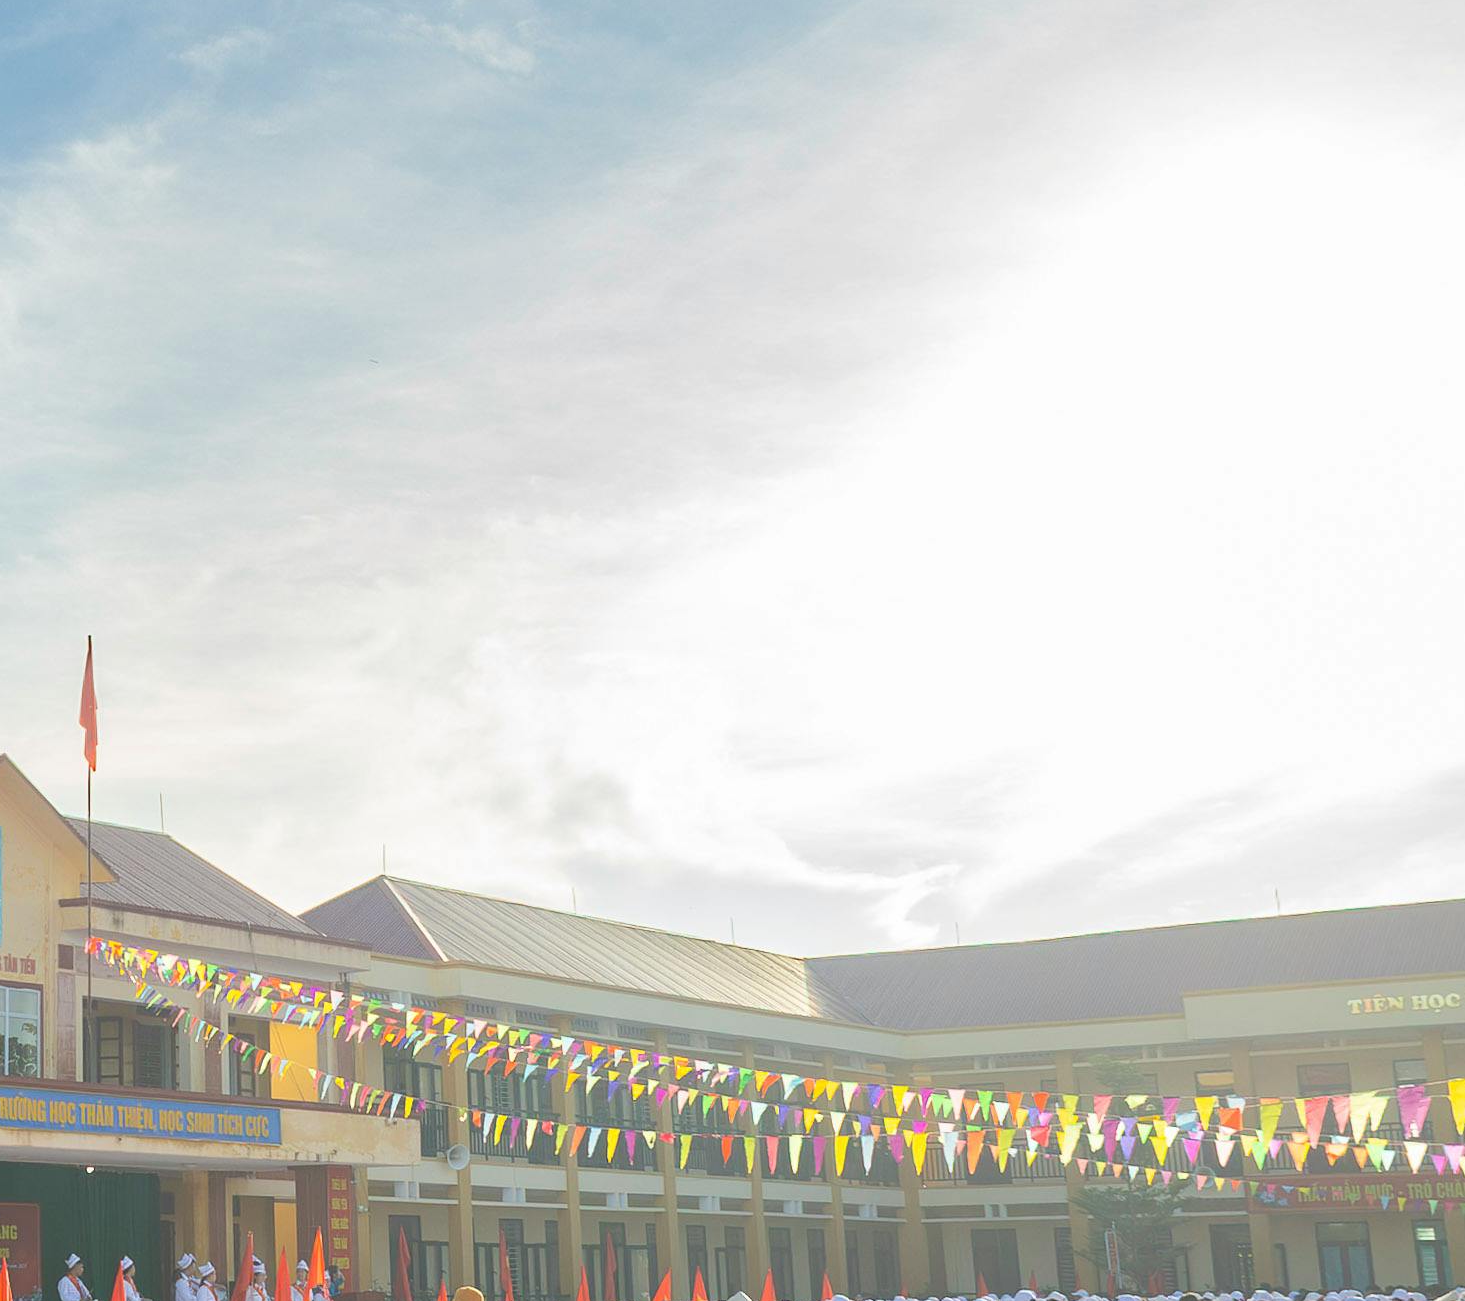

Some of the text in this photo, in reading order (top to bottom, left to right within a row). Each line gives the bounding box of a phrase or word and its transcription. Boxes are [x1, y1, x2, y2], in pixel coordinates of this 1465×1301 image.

[1411, 992, 1460, 1013] HỌC
[49, 1098, 76, 1129] HỌC
[79, 1100, 114, 1127] THÂN
[159, 1108, 183, 1136] HỌC
[186, 1110, 215, 1134] SINH
[217, 1110, 243, 1136] TÍCH
[245, 1113, 269, 1139] CỰC
